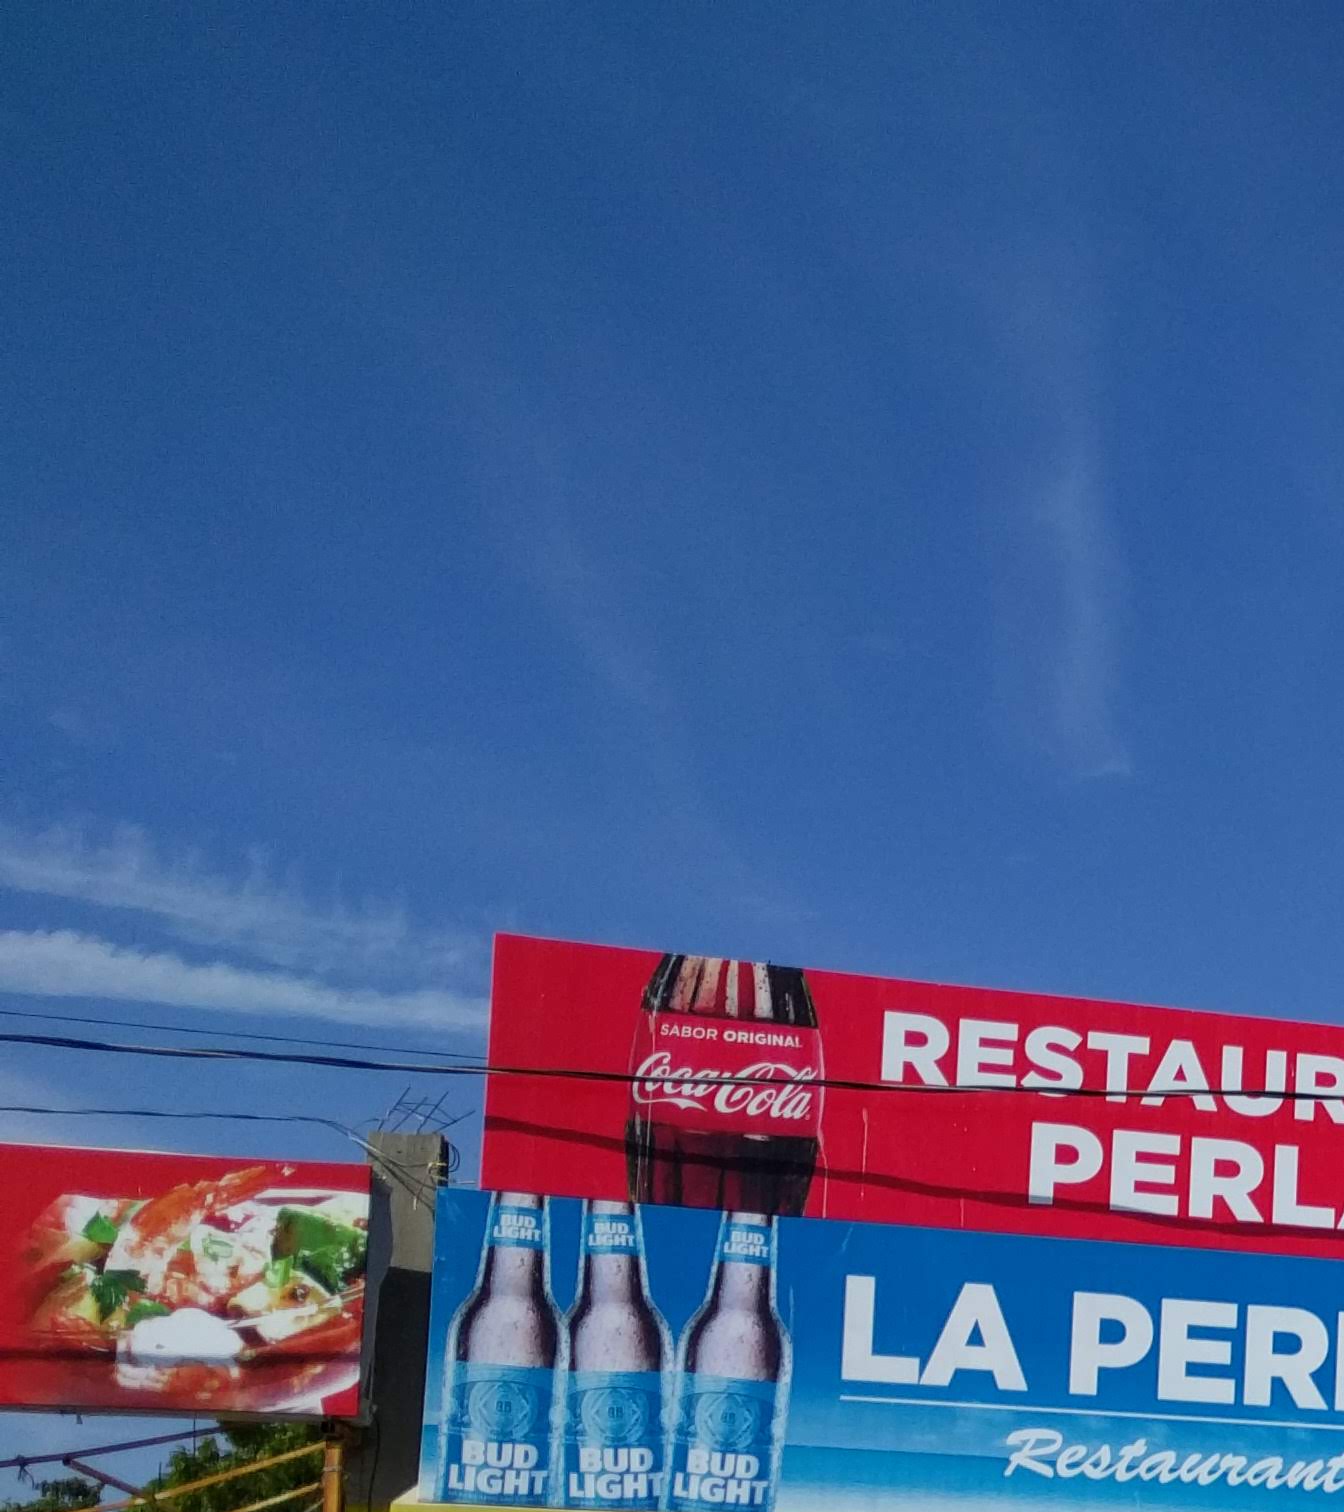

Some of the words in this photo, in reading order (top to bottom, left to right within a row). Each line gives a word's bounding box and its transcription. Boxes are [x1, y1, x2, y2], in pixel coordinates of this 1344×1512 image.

[660, 1024, 718, 1040] SABOR
[723, 1030, 803, 1048] ORIGINAL
[632, 1052, 819, 1120] Coca-Cola
[493, 1225, 542, 1241] LIGHT
[500, 1214, 536, 1229] BUD
[593, 1221, 629, 1236] BUD
[588, 1233, 635, 1247] LIGHT
[723, 1241, 769, 1258] LIGHT
[730, 1231, 765, 1245] BUD
[841, 1275, 1027, 1392] LA
[461, 1440, 539, 1469] BUD
[579, 1447, 653, 1474] BUD
[686, 1448, 760, 1479] BUD
[448, 1464, 548, 1495] LIGHT
[569, 1472, 664, 1500] LIGHT
[674, 1472, 769, 1505] LIGHT
